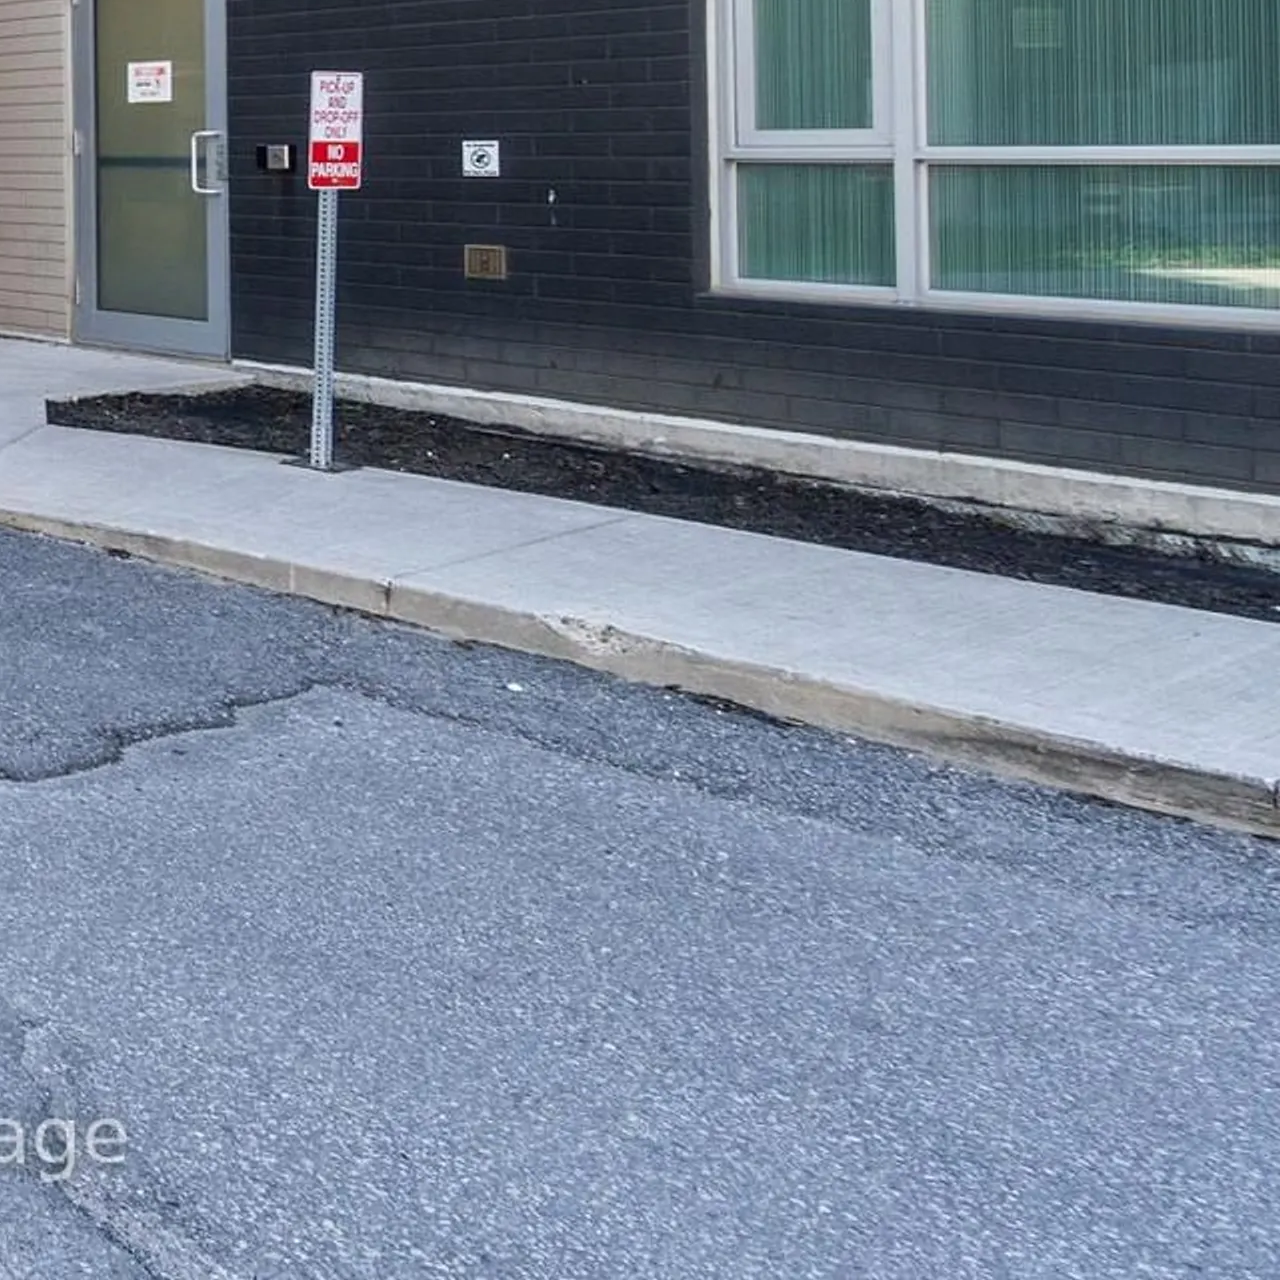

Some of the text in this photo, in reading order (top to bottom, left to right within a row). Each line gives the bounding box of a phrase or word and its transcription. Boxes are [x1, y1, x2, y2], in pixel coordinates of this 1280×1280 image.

[320, 80, 355, 94] PICK-UP
[328, 96, 347, 109] AND
[314, 110, 359, 123] DROP-OFF
[325, 125, 347, 138] ONLY
[327, 144, 345, 161] NO
[311, 162, 359, 178] PARKING
